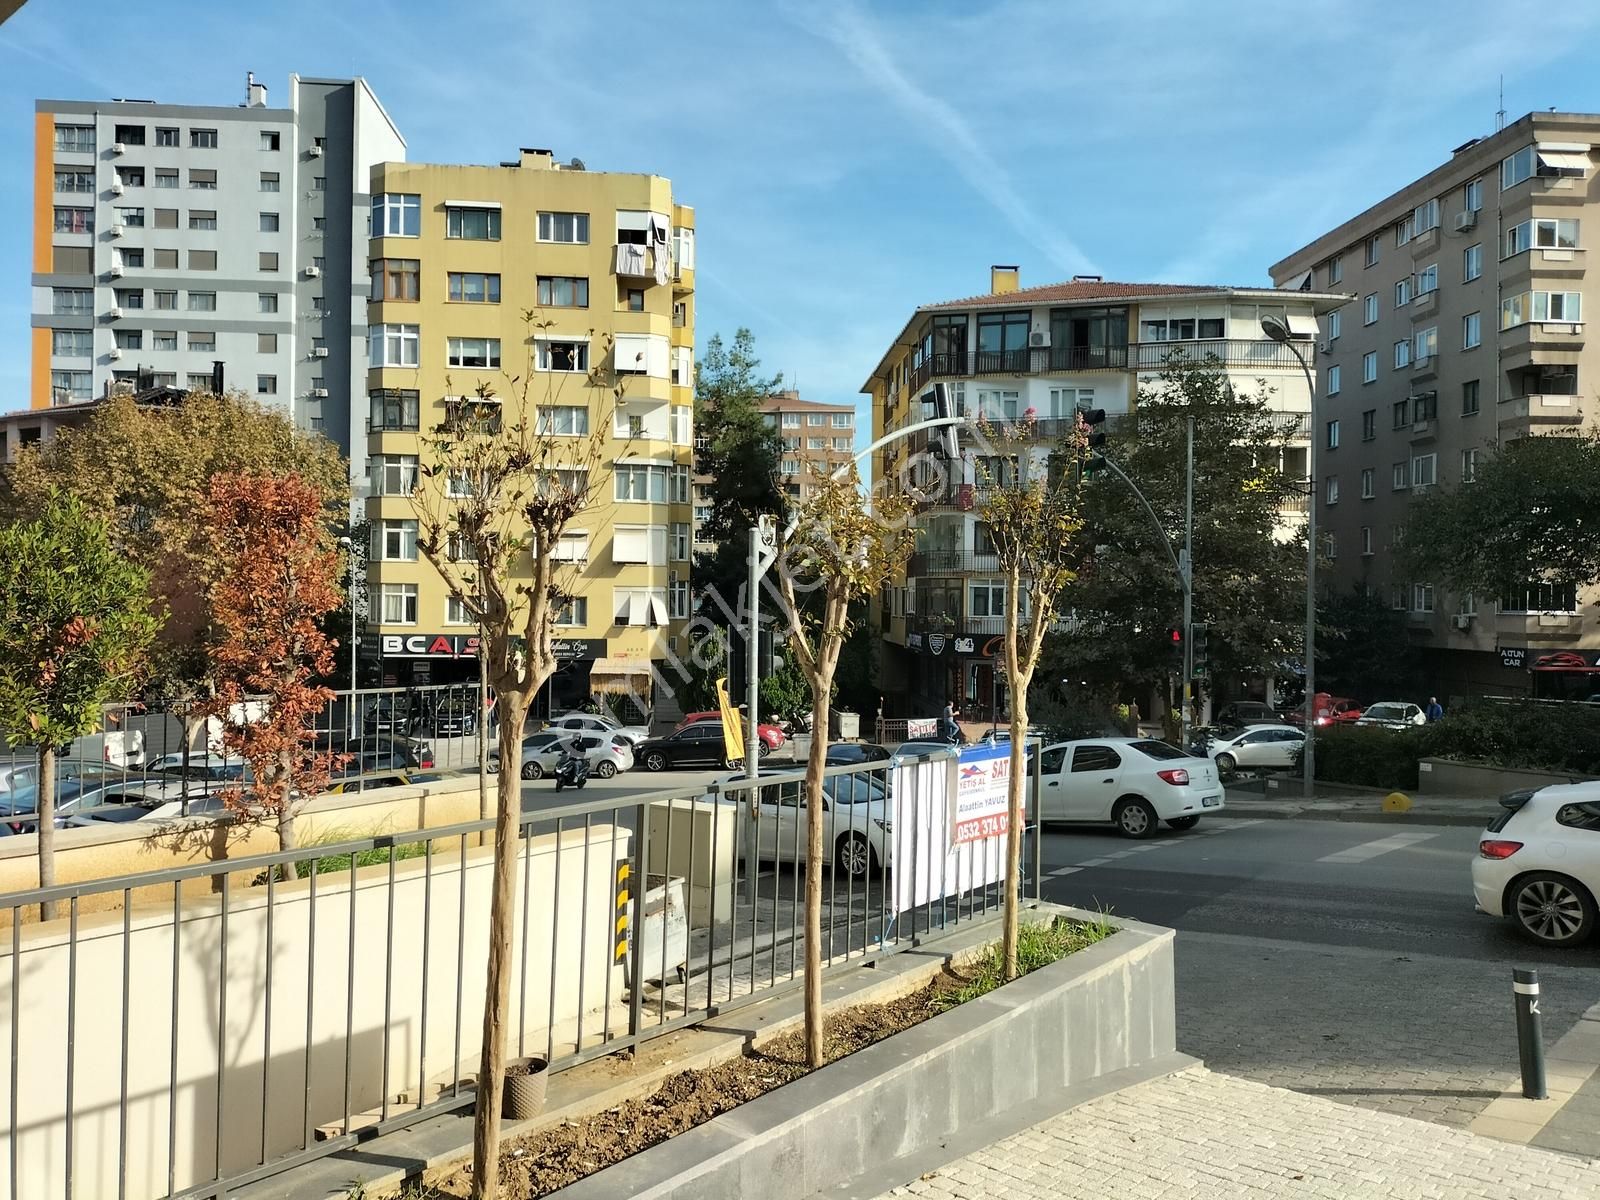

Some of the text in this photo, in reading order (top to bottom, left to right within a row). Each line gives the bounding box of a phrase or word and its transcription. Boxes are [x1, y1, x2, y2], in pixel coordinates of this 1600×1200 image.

[382, 636, 454, 653] BCA
[1503, 659, 1520, 667] CAR
[985, 795, 1006, 807] YAVUZ
[957, 821, 980, 841] 0532
[982, 816, 998, 835] 374
